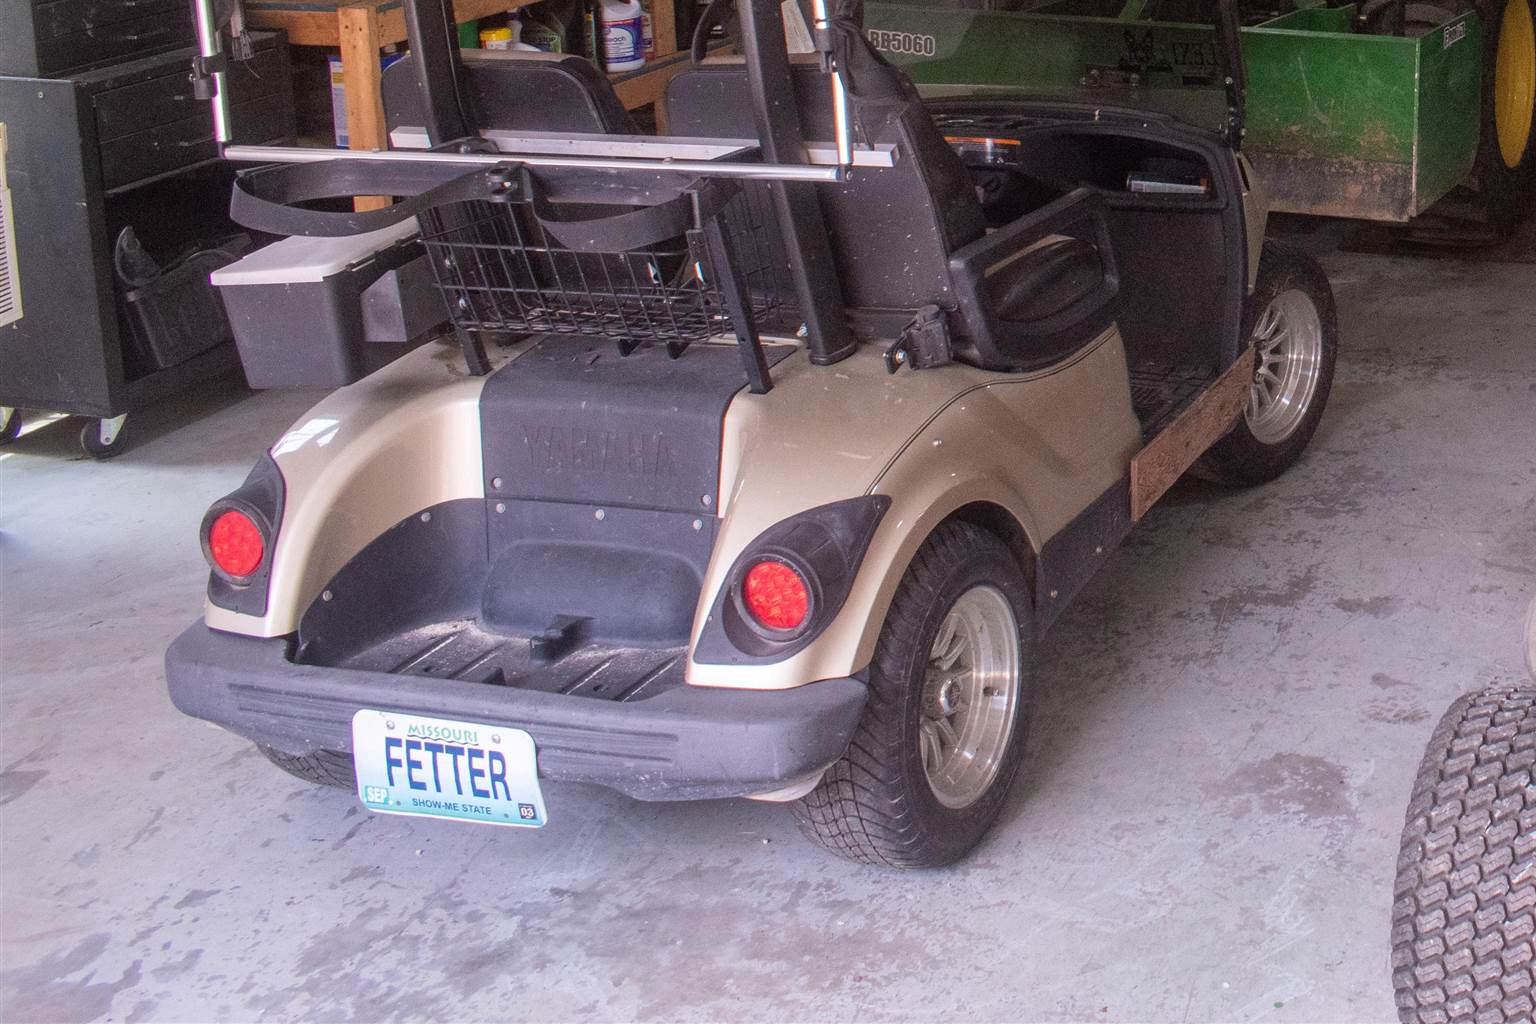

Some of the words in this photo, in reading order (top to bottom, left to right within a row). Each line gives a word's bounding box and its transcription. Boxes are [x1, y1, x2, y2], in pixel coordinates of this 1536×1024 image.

[523, 425, 676, 478] YAMAHA
[408, 723, 478, 743] MISSOURI
[385, 736, 513, 802] FETTER
[367, 786, 388, 803] SEP
[412, 798, 460, 813] SHOW-ME
[462, 801, 493, 816] STATE
[520, 807, 535, 819] 03
